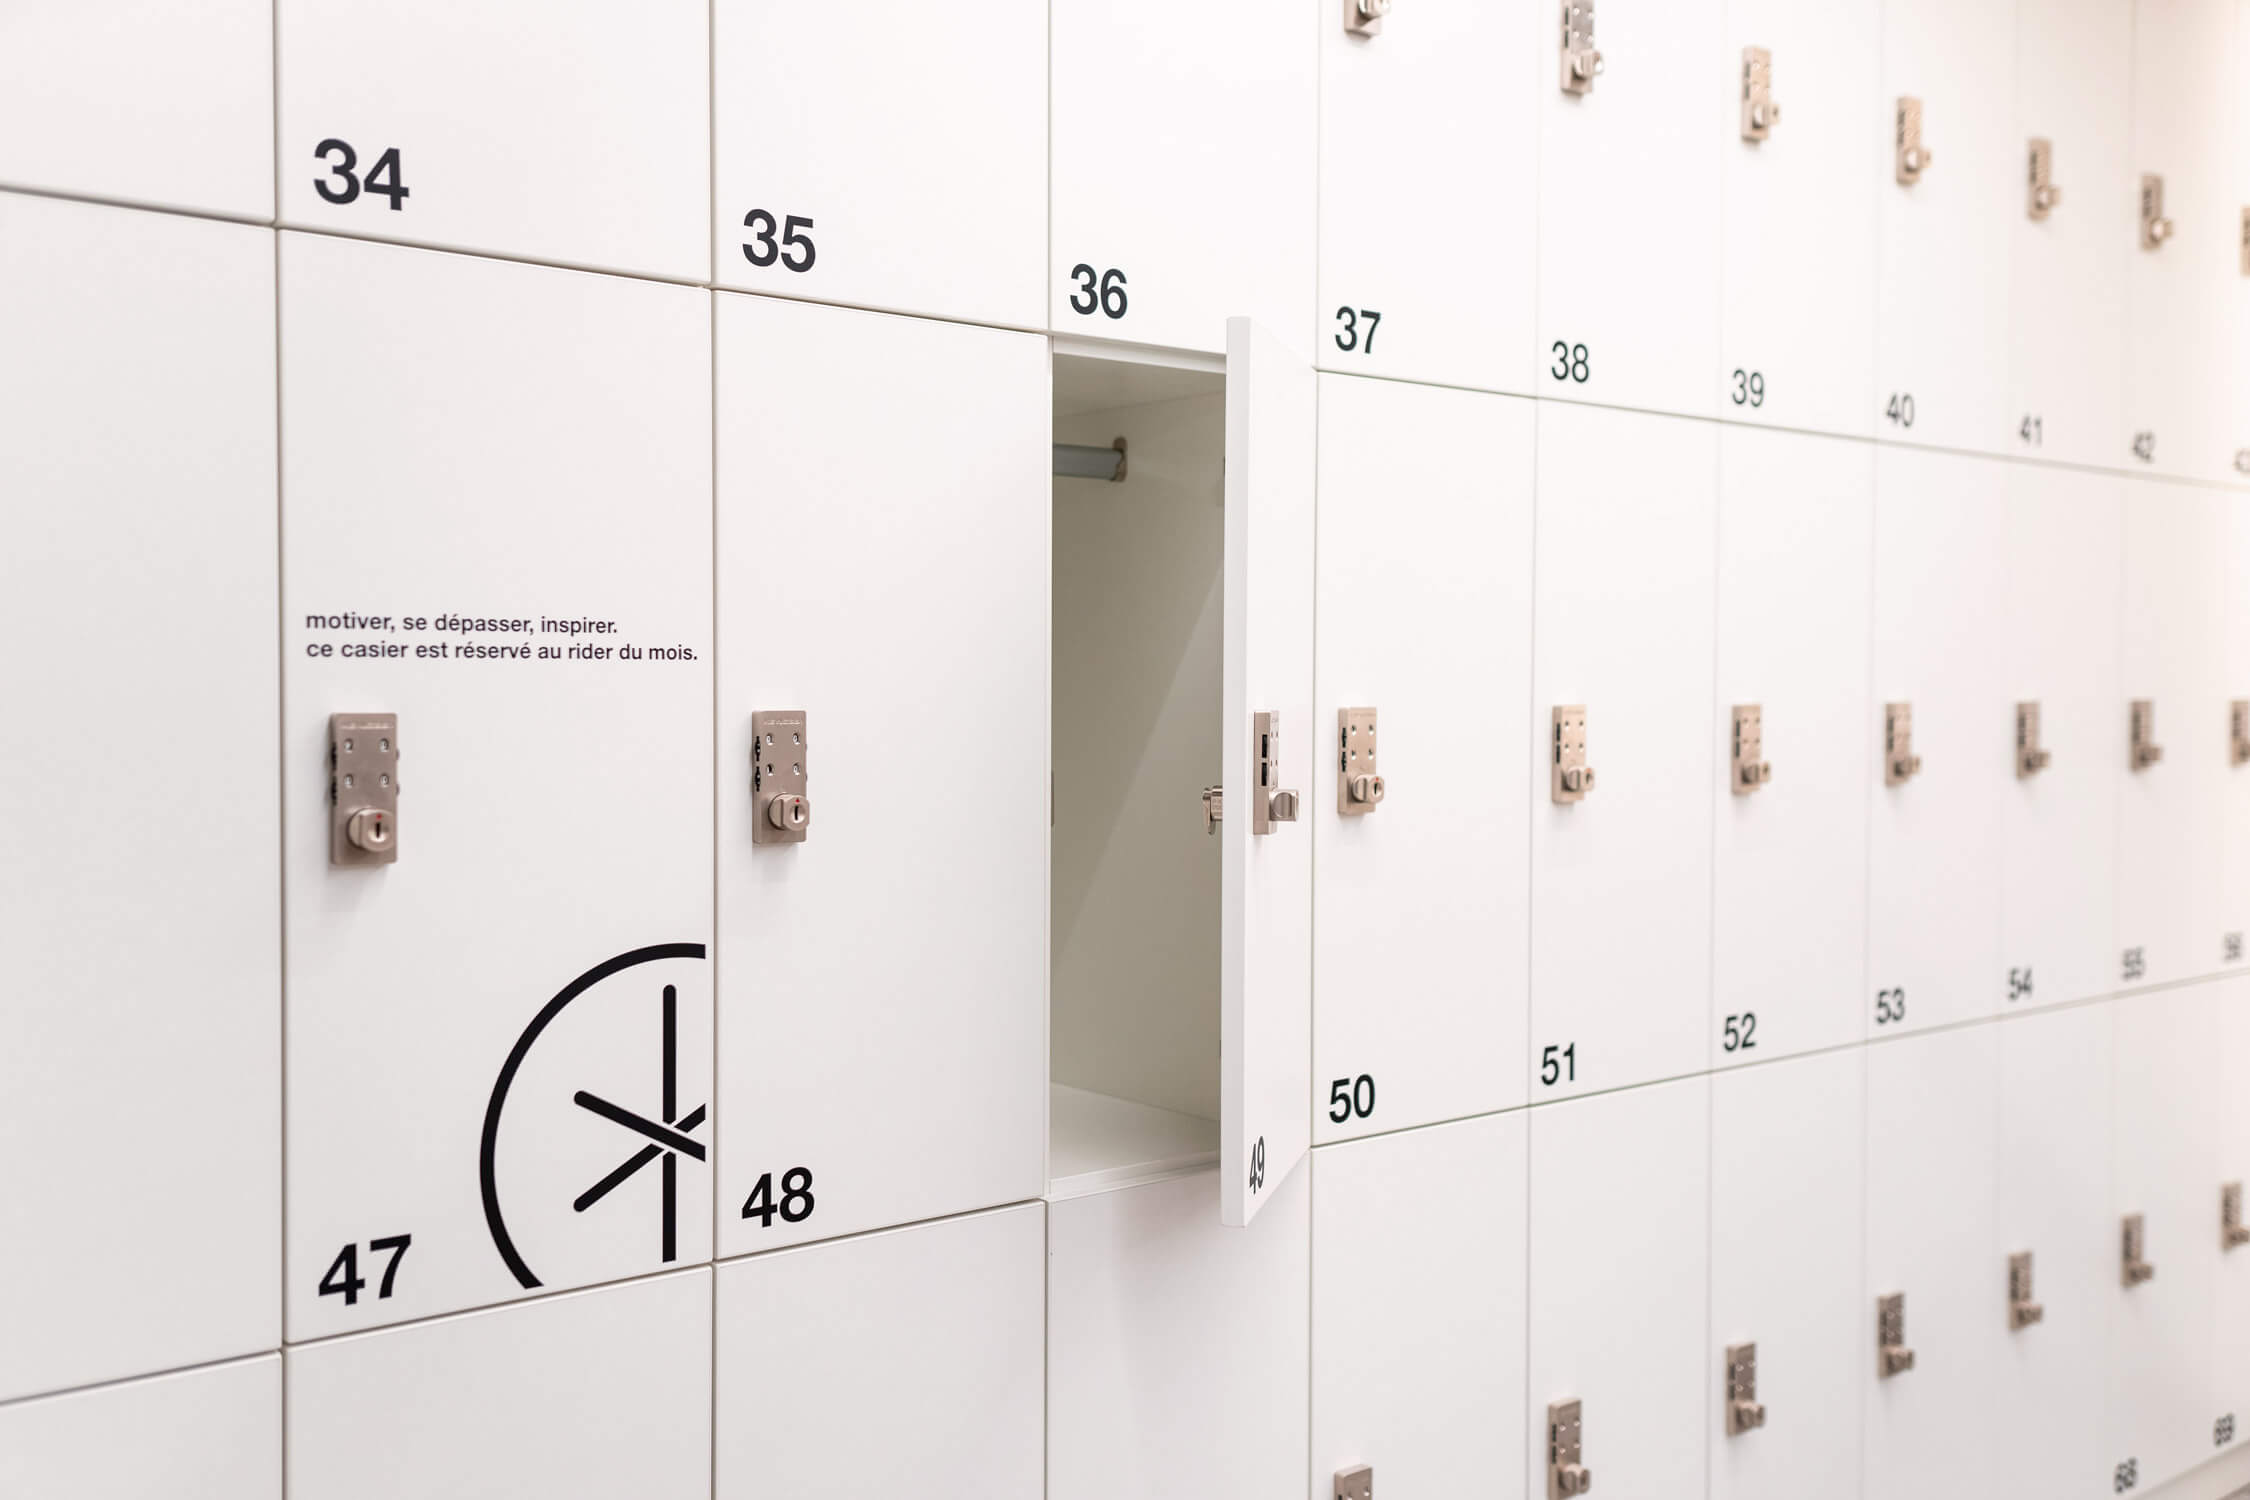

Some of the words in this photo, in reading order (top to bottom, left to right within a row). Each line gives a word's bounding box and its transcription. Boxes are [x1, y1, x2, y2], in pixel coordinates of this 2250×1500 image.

[313, 138, 410, 212] 34
[742, 208, 816, 274] 35
[1069, 263, 1128, 320] 36
[1334, 305, 1381, 355] 37
[1551, 340, 1590, 384] 38
[1732, 368, 1765, 408] 39
[1885, 394, 1915, 428] 40
[2019, 415, 2042, 445] 41
[306, 611, 395, 633] motiver,
[403, 616, 428, 631] se
[434, 613, 534, 636] dépasser,
[541, 615, 618, 637] inspirer.
[306, 643, 333, 658] ce
[341, 640, 409, 658] casier
[415, 642, 448, 659] est
[455, 641, 531, 659] réservé
[537, 646, 562, 660] au
[568, 642, 614, 660] rider
[619, 643, 642, 660] du
[648, 644, 699, 661] mois.
[1876, 987, 1905, 1025] 53
[2008, 967, 2033, 1001] 54
[1723, 1012, 1757, 1053] 52
[1541, 1042, 1576, 1086] 51
[1328, 1074, 1376, 1127] 50
[1249, 1135, 1265, 1195] 49
[741, 1166, 815, 1228] 48
[317, 1233, 413, 1307] 47
